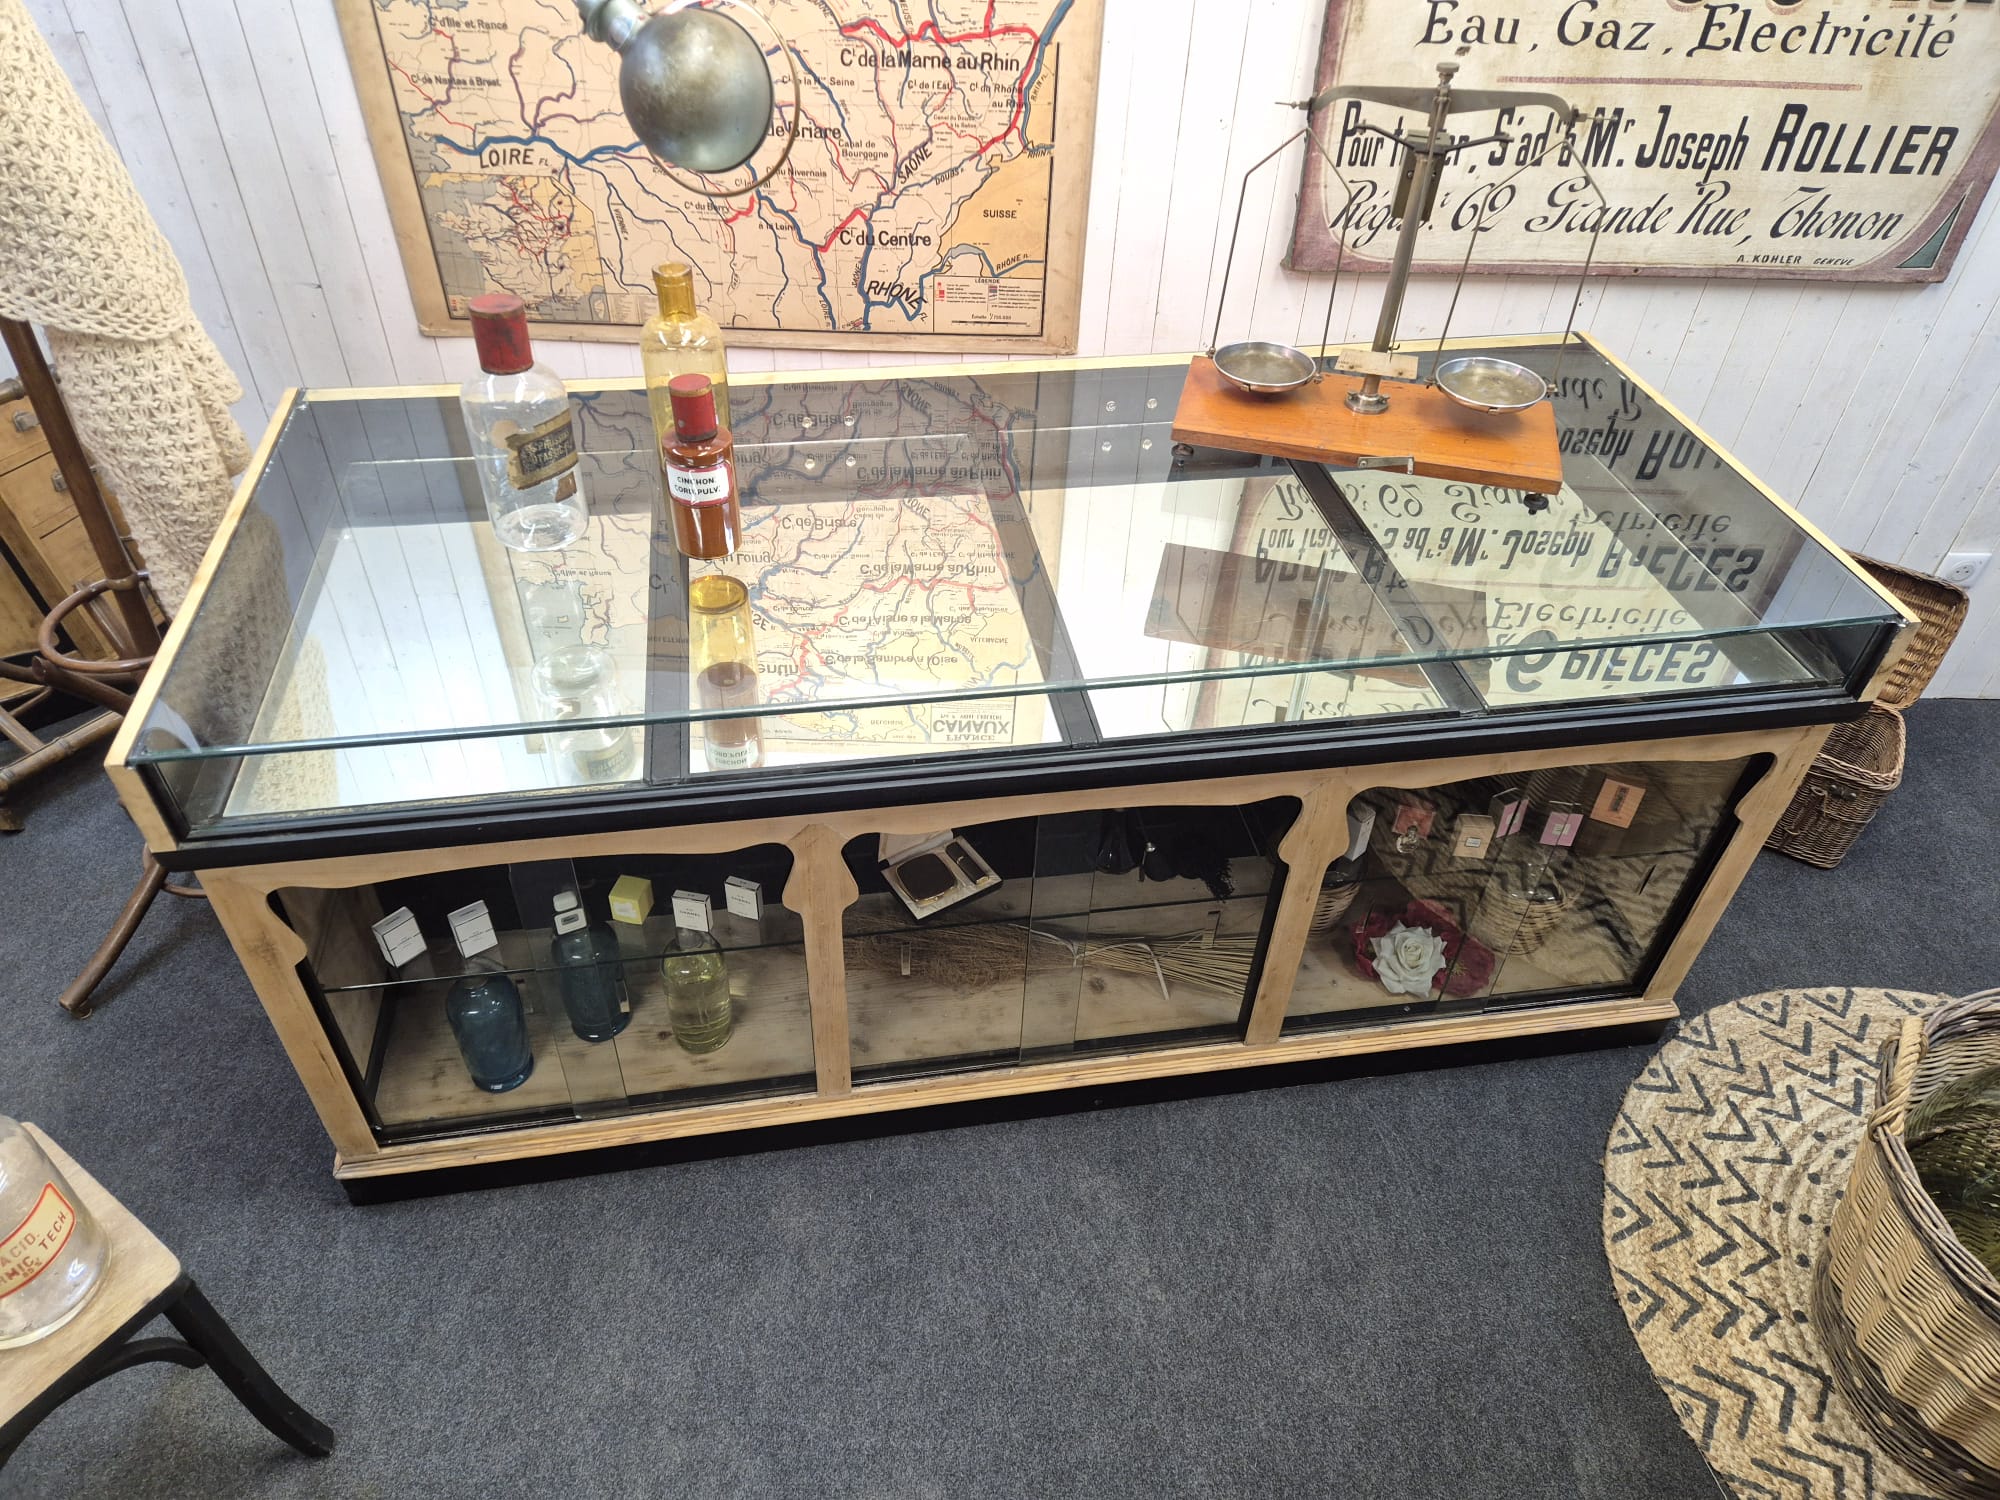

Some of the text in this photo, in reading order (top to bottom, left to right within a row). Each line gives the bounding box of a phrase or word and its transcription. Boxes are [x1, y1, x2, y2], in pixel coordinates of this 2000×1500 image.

[1414, 0, 1959, 59] Eau, Gaz, Electricité
[858, 49, 877, 68] de
[881, 49, 896, 69] la
[899, 51, 951, 70] Marne
[956, 55, 980, 70] au
[981, 52, 1020, 72] Rhin
[1335, 100, 1385, 168] Pour
[1634, 105, 1750, 184] Joseph
[1760, 103, 1960, 177] ROLLIER
[479, 148, 534, 170] LOIRE
[842, 148, 889, 162] Bourgogne
[982, 209, 1017, 219] SUISSE
[1450, 182, 1517, 234] 62
[1524, 176, 1674, 235] Grande
[1672, 180, 1753, 248] Rue,
[1769, 185, 1905, 242] Thonon
[879, 230, 932, 247] Centre
[1751, 254, 1802, 265] KOHLER
[38, 1211, 66, 1250] TECH
